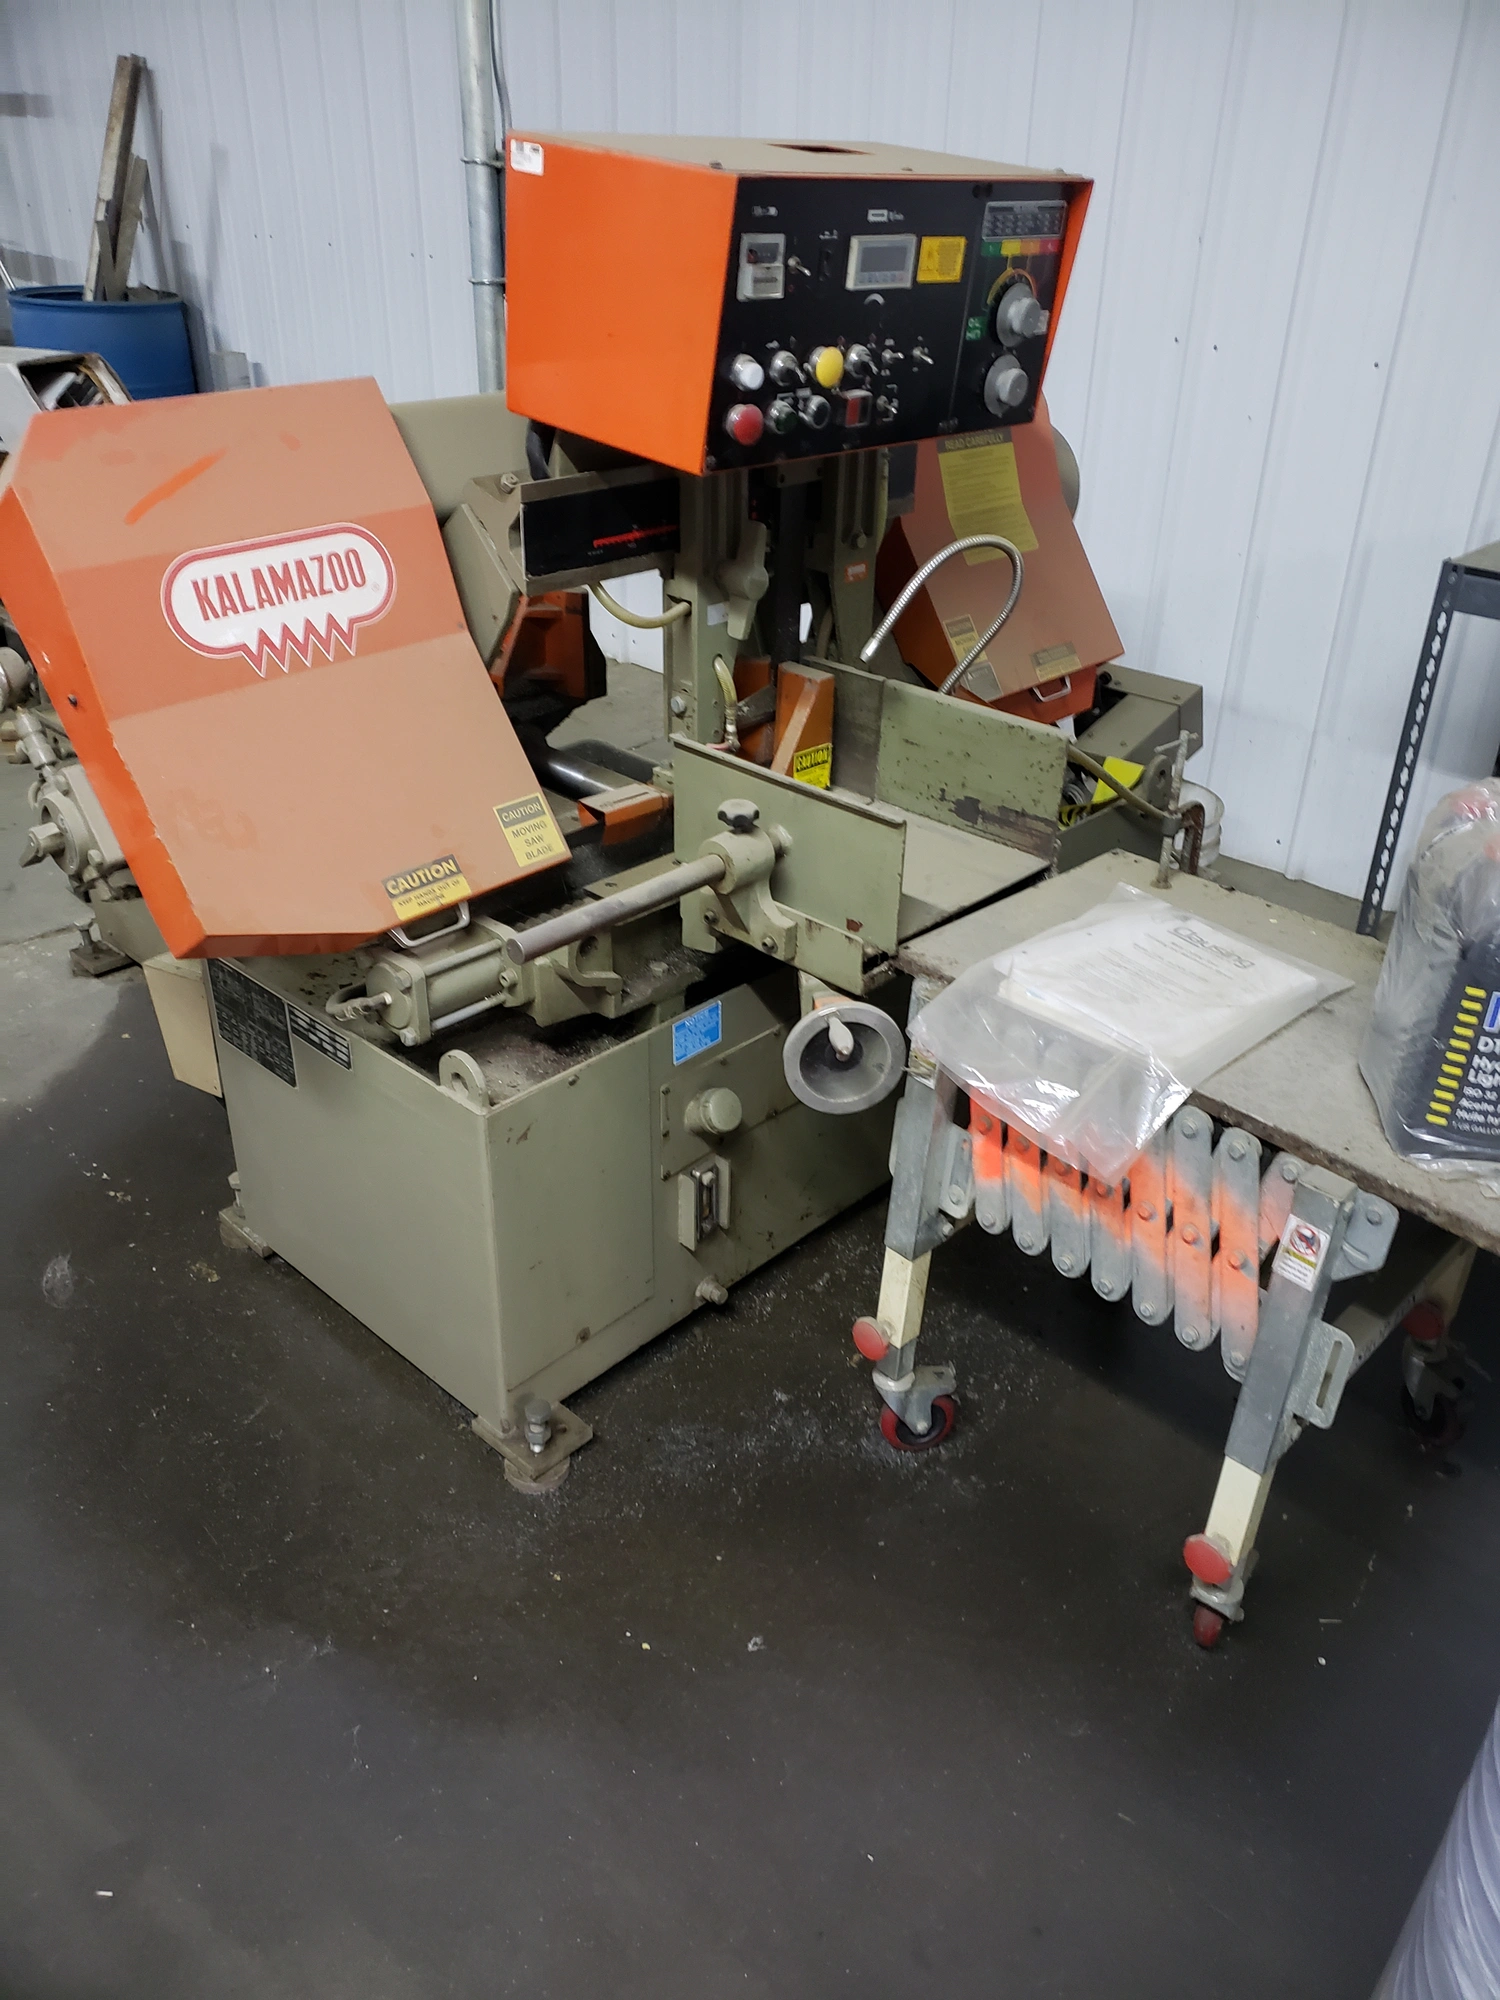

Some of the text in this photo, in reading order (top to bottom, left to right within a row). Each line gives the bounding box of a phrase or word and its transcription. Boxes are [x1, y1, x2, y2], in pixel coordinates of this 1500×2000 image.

[191, 548, 366, 621] KALAMAZOO
[501, 802, 542, 822] CAUTION
[511, 820, 548, 839] MOVING
[524, 834, 545, 848] SAW
[525, 844, 553, 861] BLADE
[386, 859, 458, 895] CAUTION
